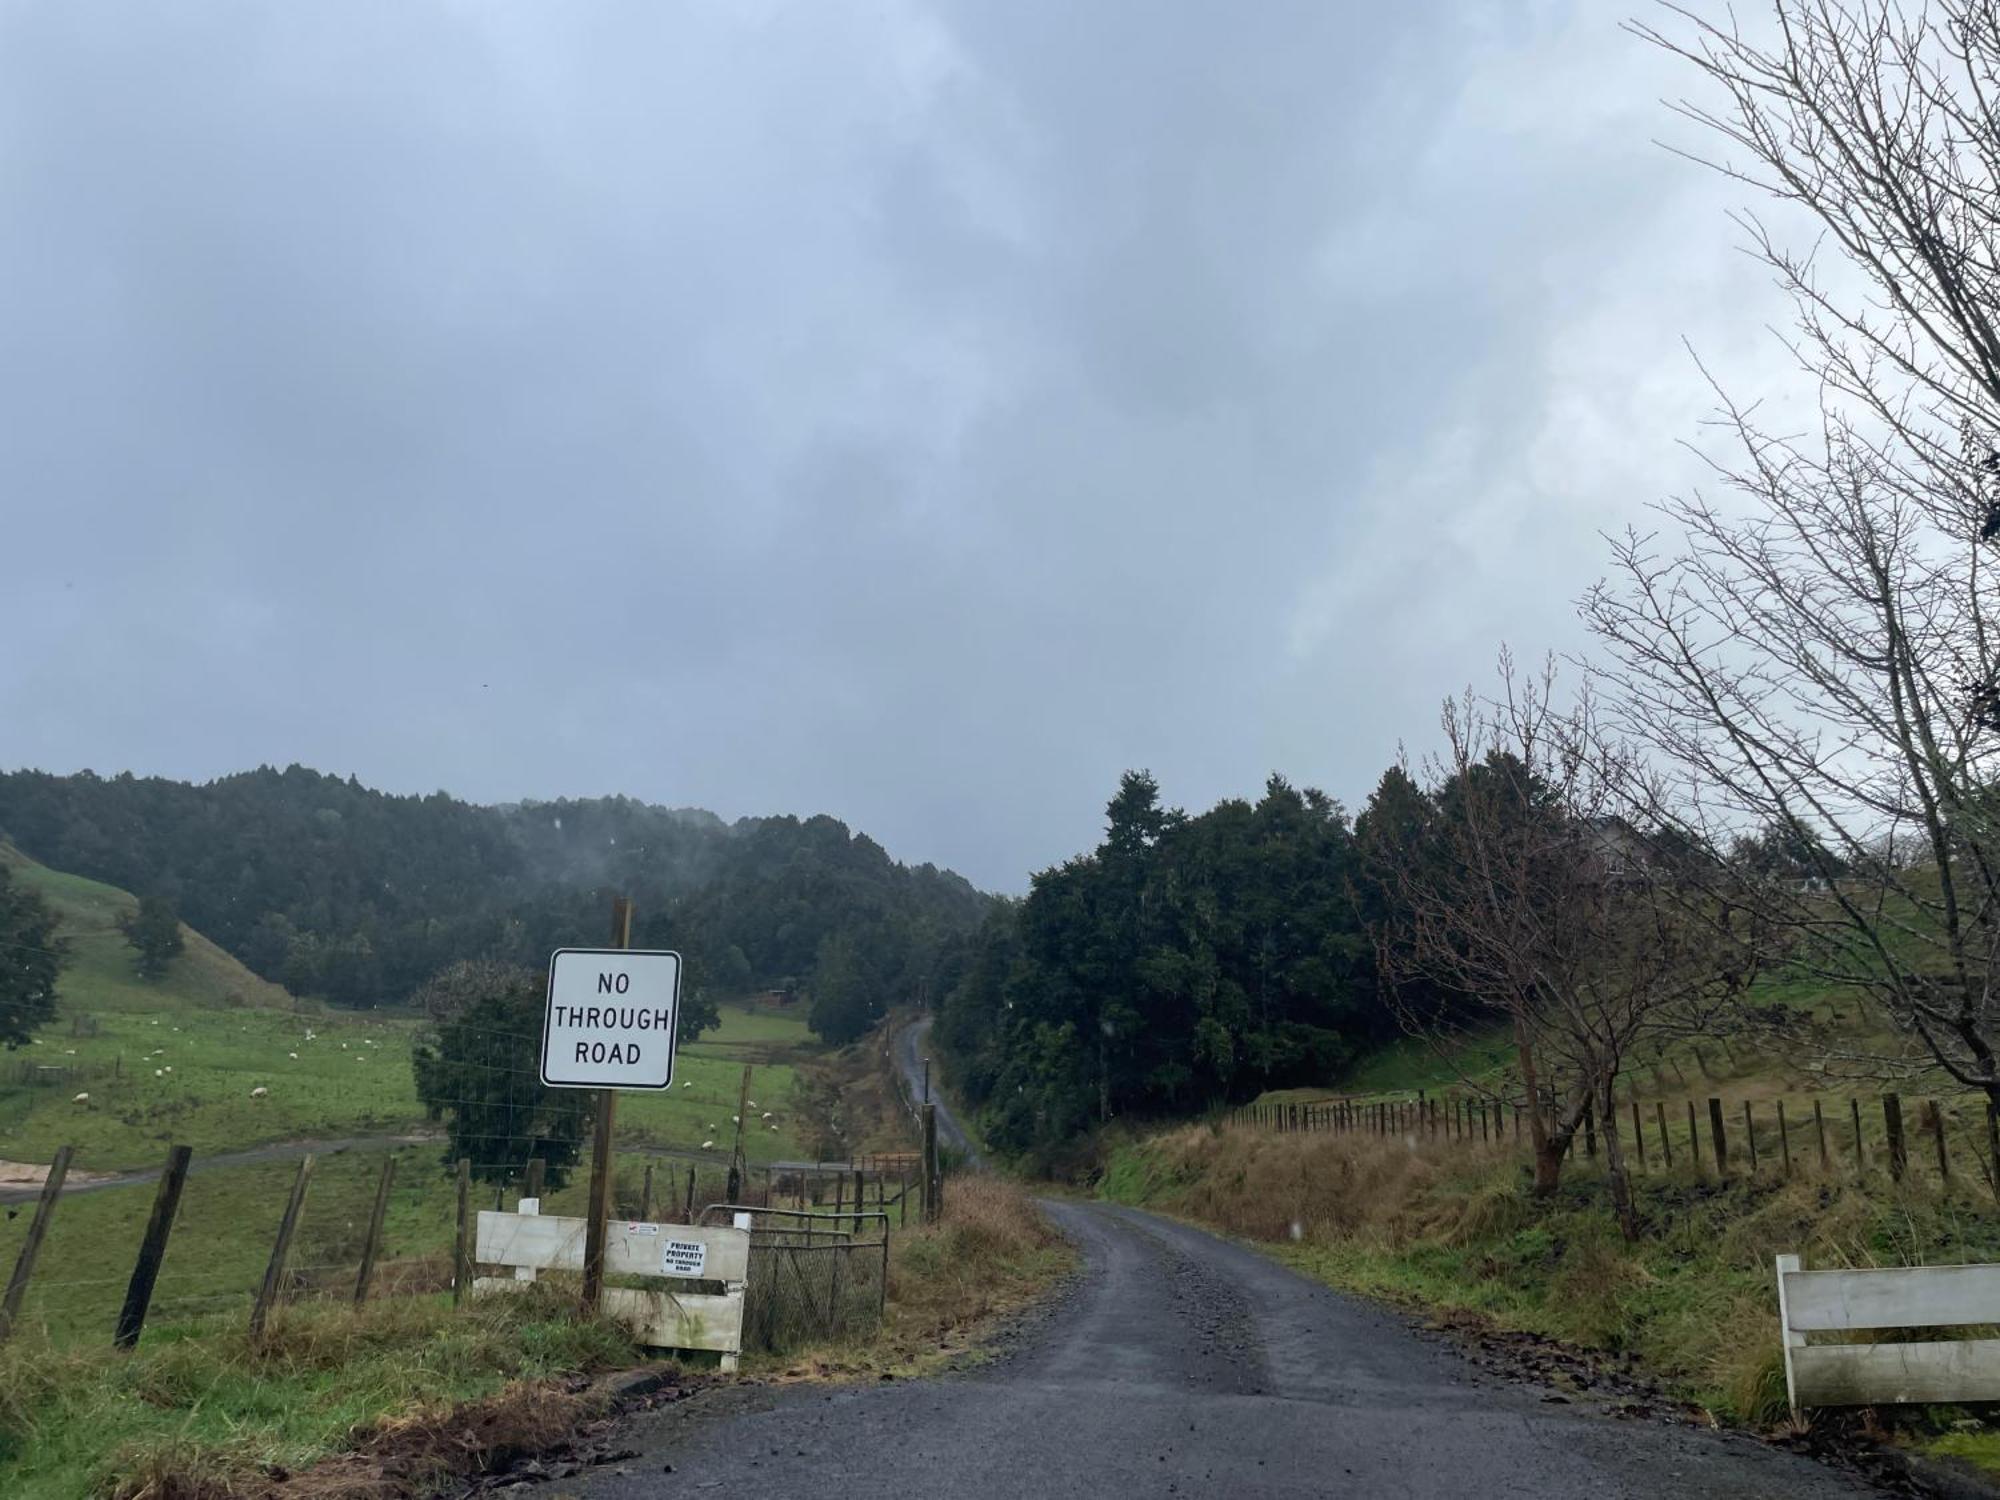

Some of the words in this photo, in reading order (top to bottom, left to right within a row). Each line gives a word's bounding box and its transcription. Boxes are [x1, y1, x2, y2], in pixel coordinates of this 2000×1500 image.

[598, 973, 629, 994] NO
[555, 1006, 669, 1030] THROUGH
[575, 1042, 641, 1065] ROAD
[666, 1250, 703, 1259] PROPERTY
[671, 1242, 700, 1251] PRIVATE
